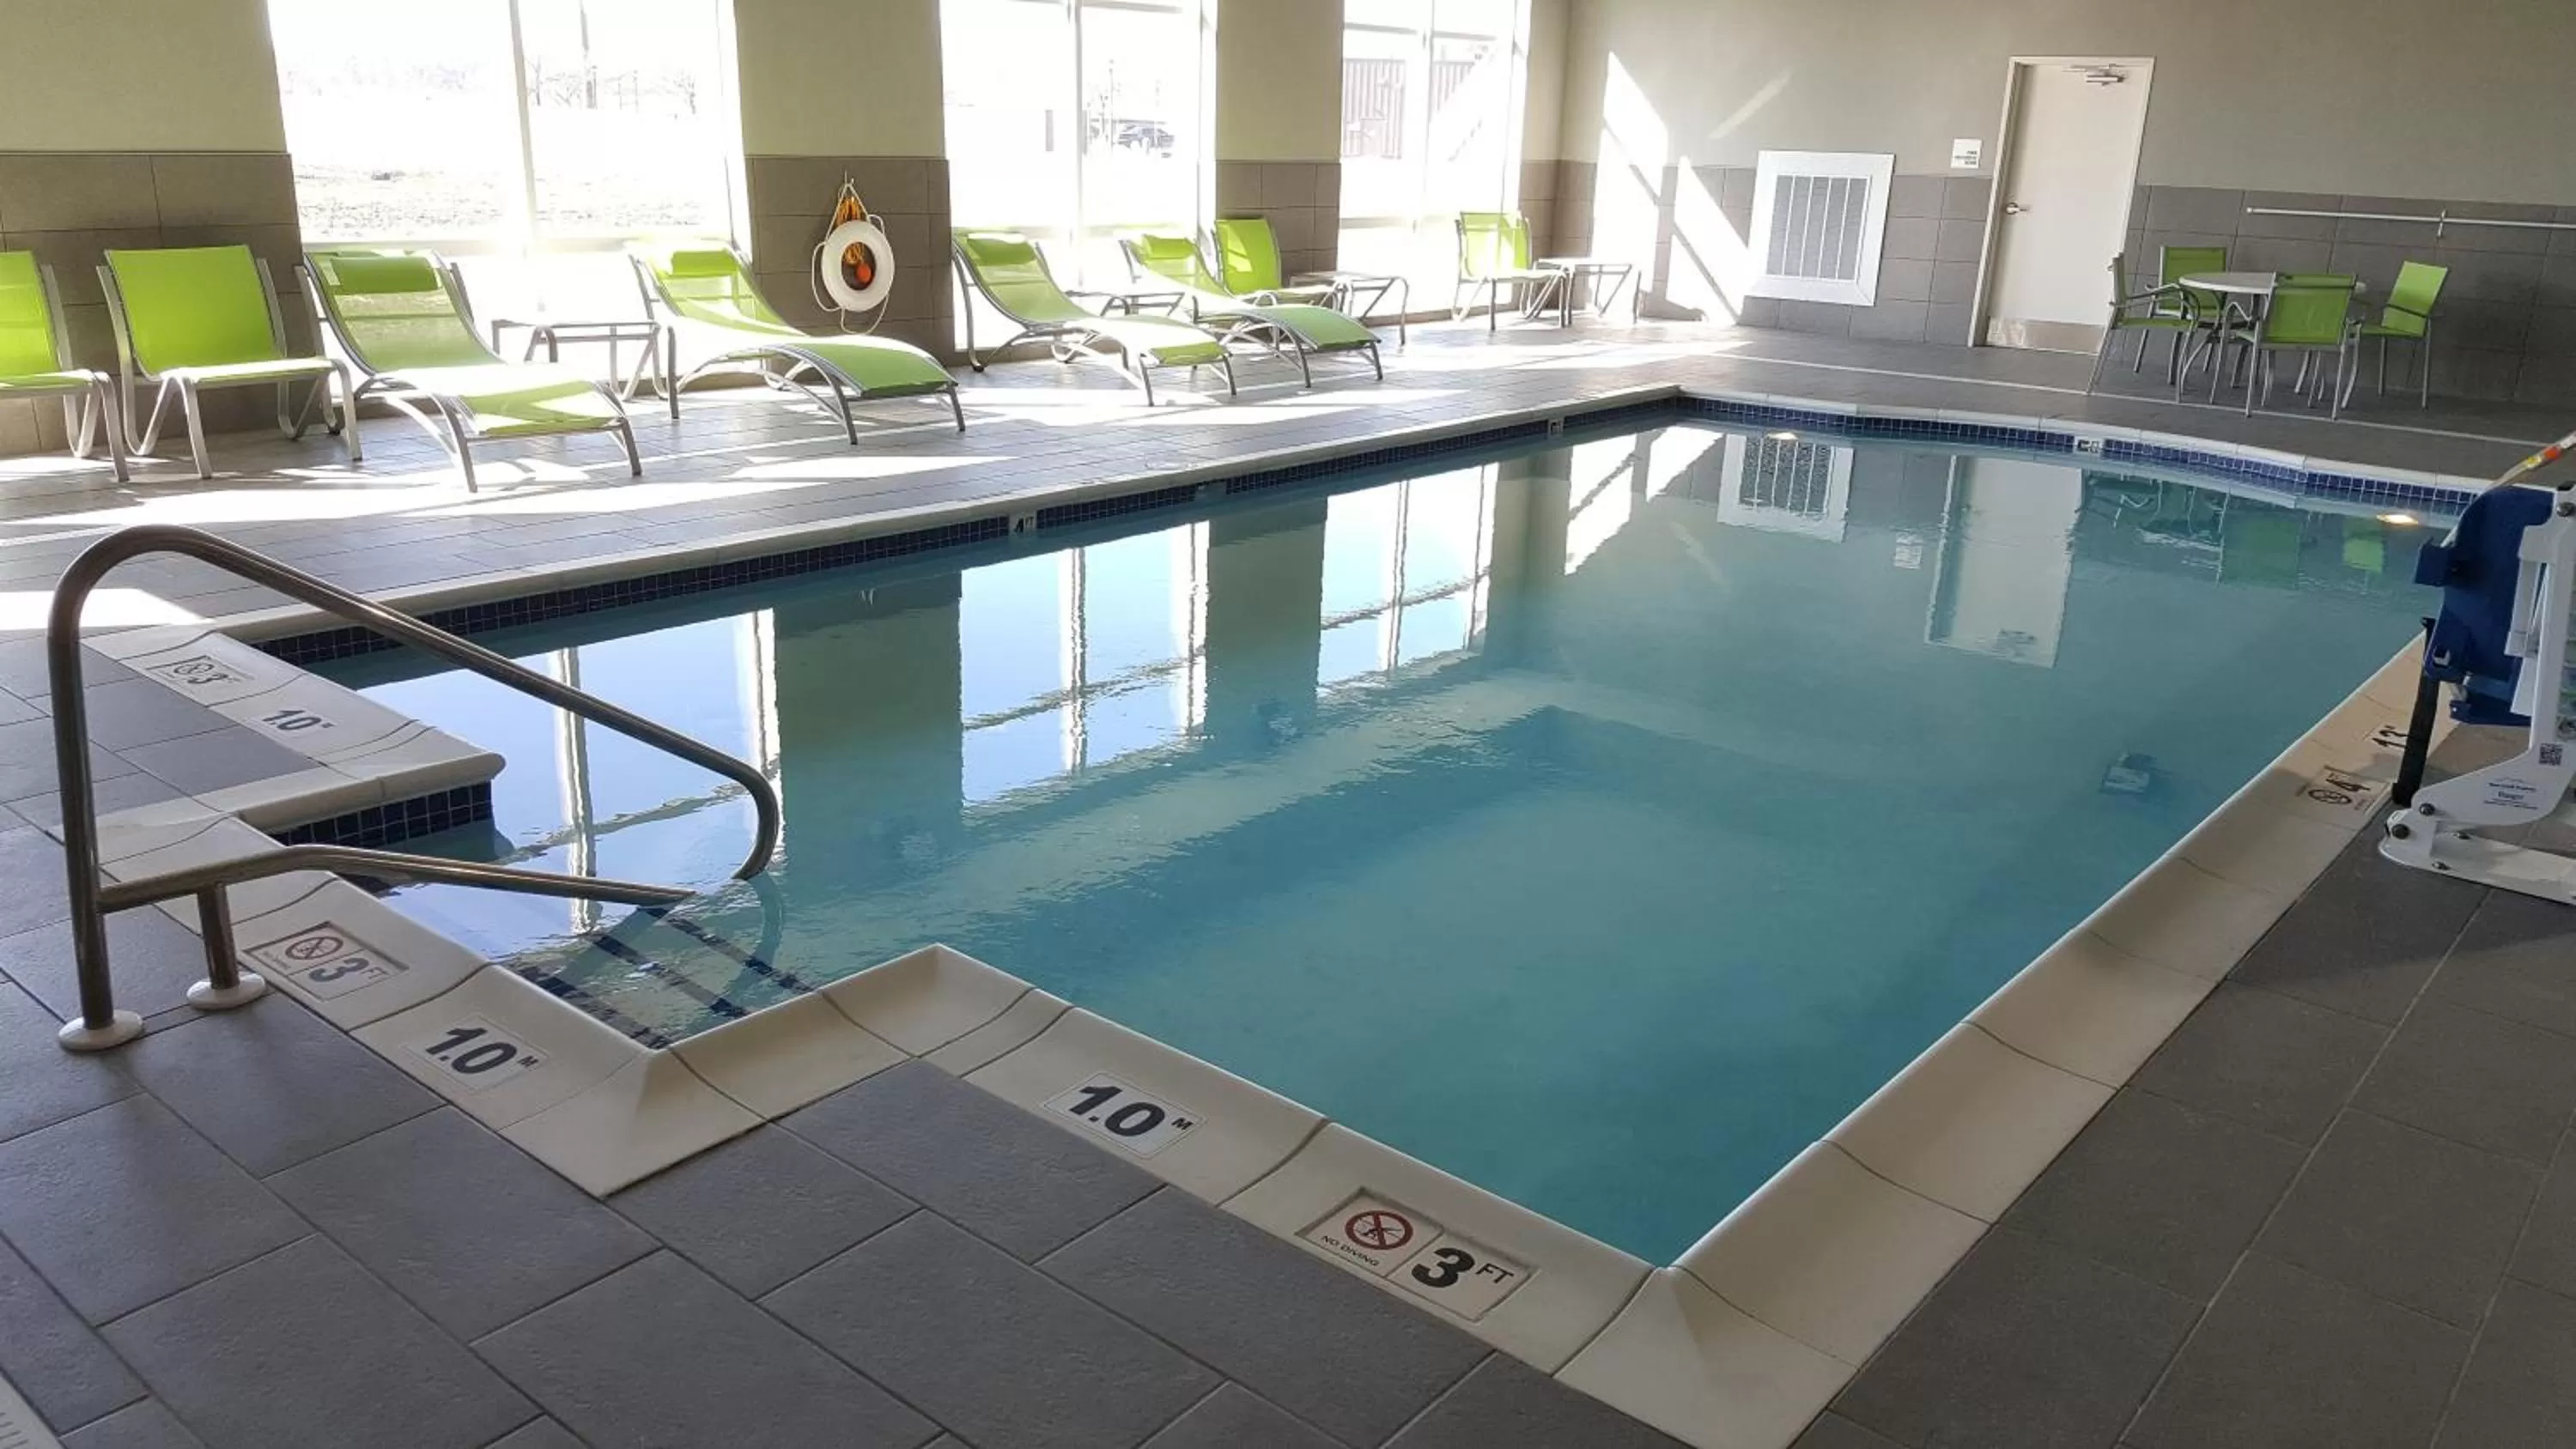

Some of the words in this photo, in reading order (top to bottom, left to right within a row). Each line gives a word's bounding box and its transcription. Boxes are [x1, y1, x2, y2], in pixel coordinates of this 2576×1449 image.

[262, 710, 322, 731] 1.0
[309, 957, 369, 982] 3
[360, 967, 389, 979] FT
[426, 1028, 518, 1074] 1.0
[518, 1055, 539, 1068] M
[1068, 1086, 1165, 1137] 1.0
[1171, 1118, 1194, 1131] M
[1321, 1235, 1340, 1246] NO
[1340, 1244, 1380, 1266] DIVING
[1411, 1247, 1475, 1288] 3
[1476, 1263, 1515, 1284] FT
